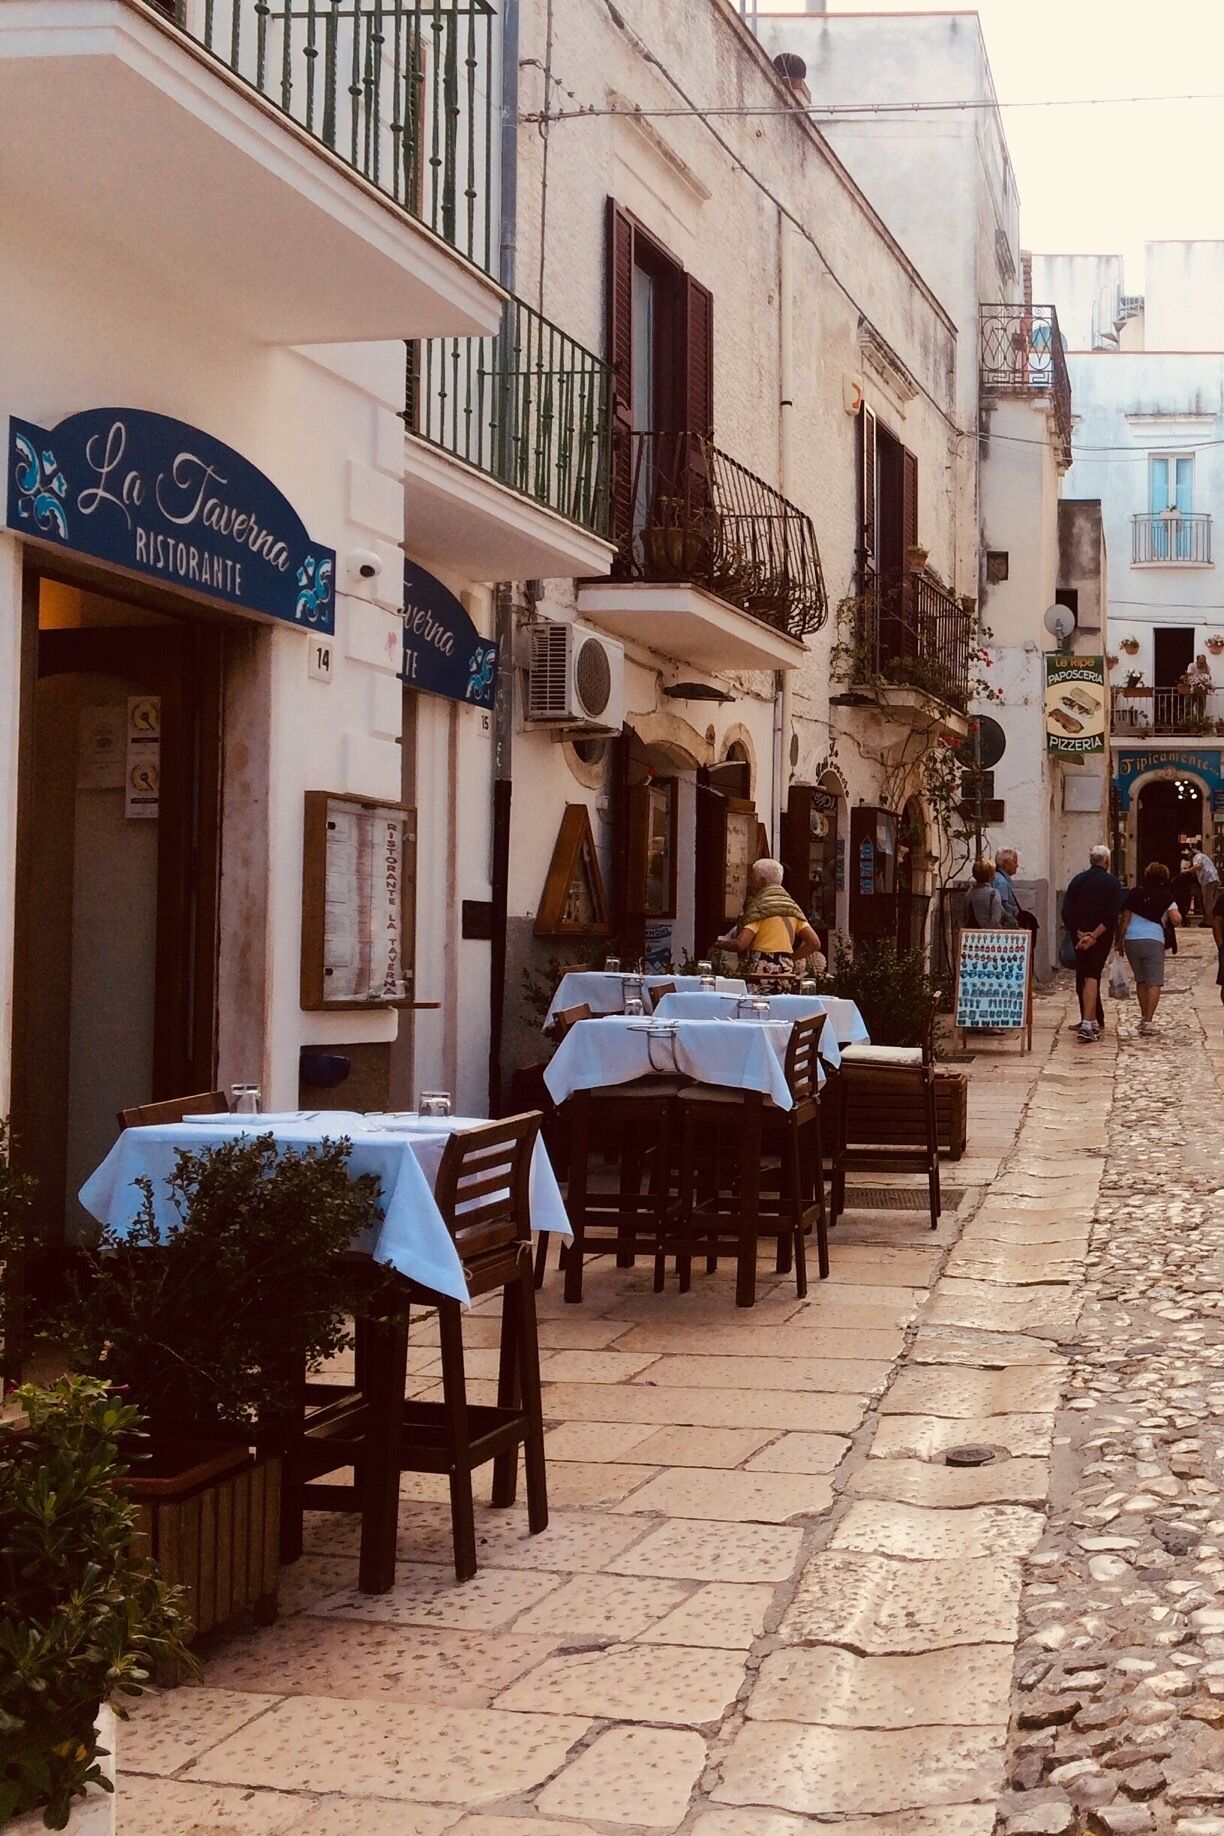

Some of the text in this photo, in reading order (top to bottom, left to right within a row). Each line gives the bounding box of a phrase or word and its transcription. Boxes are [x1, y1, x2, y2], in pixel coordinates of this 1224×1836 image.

[77, 422, 290, 572] La Taverna
[136, 526, 242, 596] RISTORANTE
[316, 647, 330, 671] 14
[1048, 669, 1104, 685] PAPOSCERIA
[481, 715, 489, 730] 15
[1049, 736, 1103, 752] PIZZERIA
[383, 823, 399, 996] RISTORANTE LA TAVERNA
